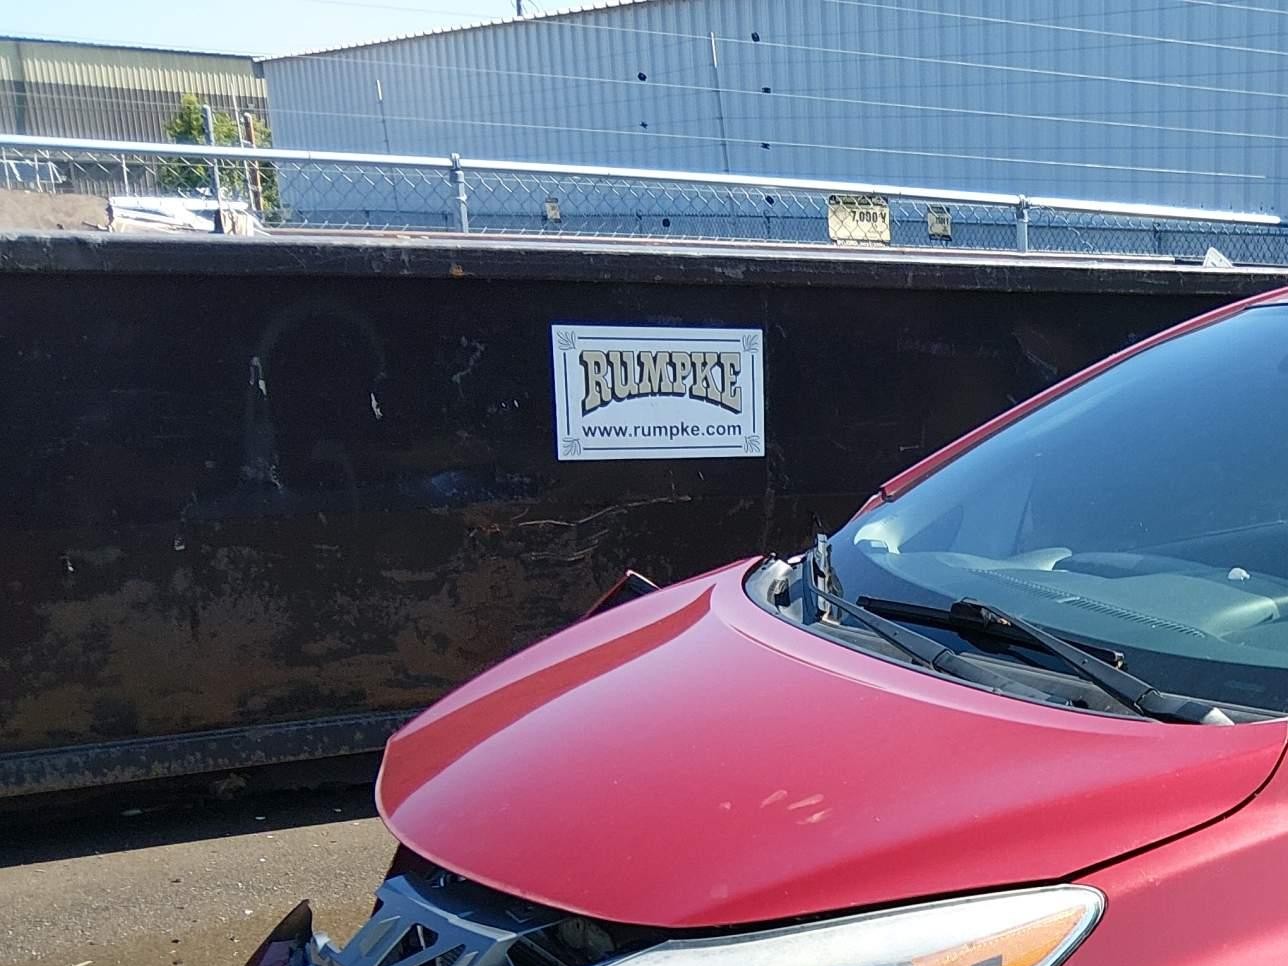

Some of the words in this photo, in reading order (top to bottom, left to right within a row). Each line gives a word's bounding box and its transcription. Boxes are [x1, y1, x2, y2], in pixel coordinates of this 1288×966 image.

[851, 210, 878, 224] 7,000
[579, 350, 742, 417] RUMPKE
[582, 421, 742, 440] www.rumpke.com
